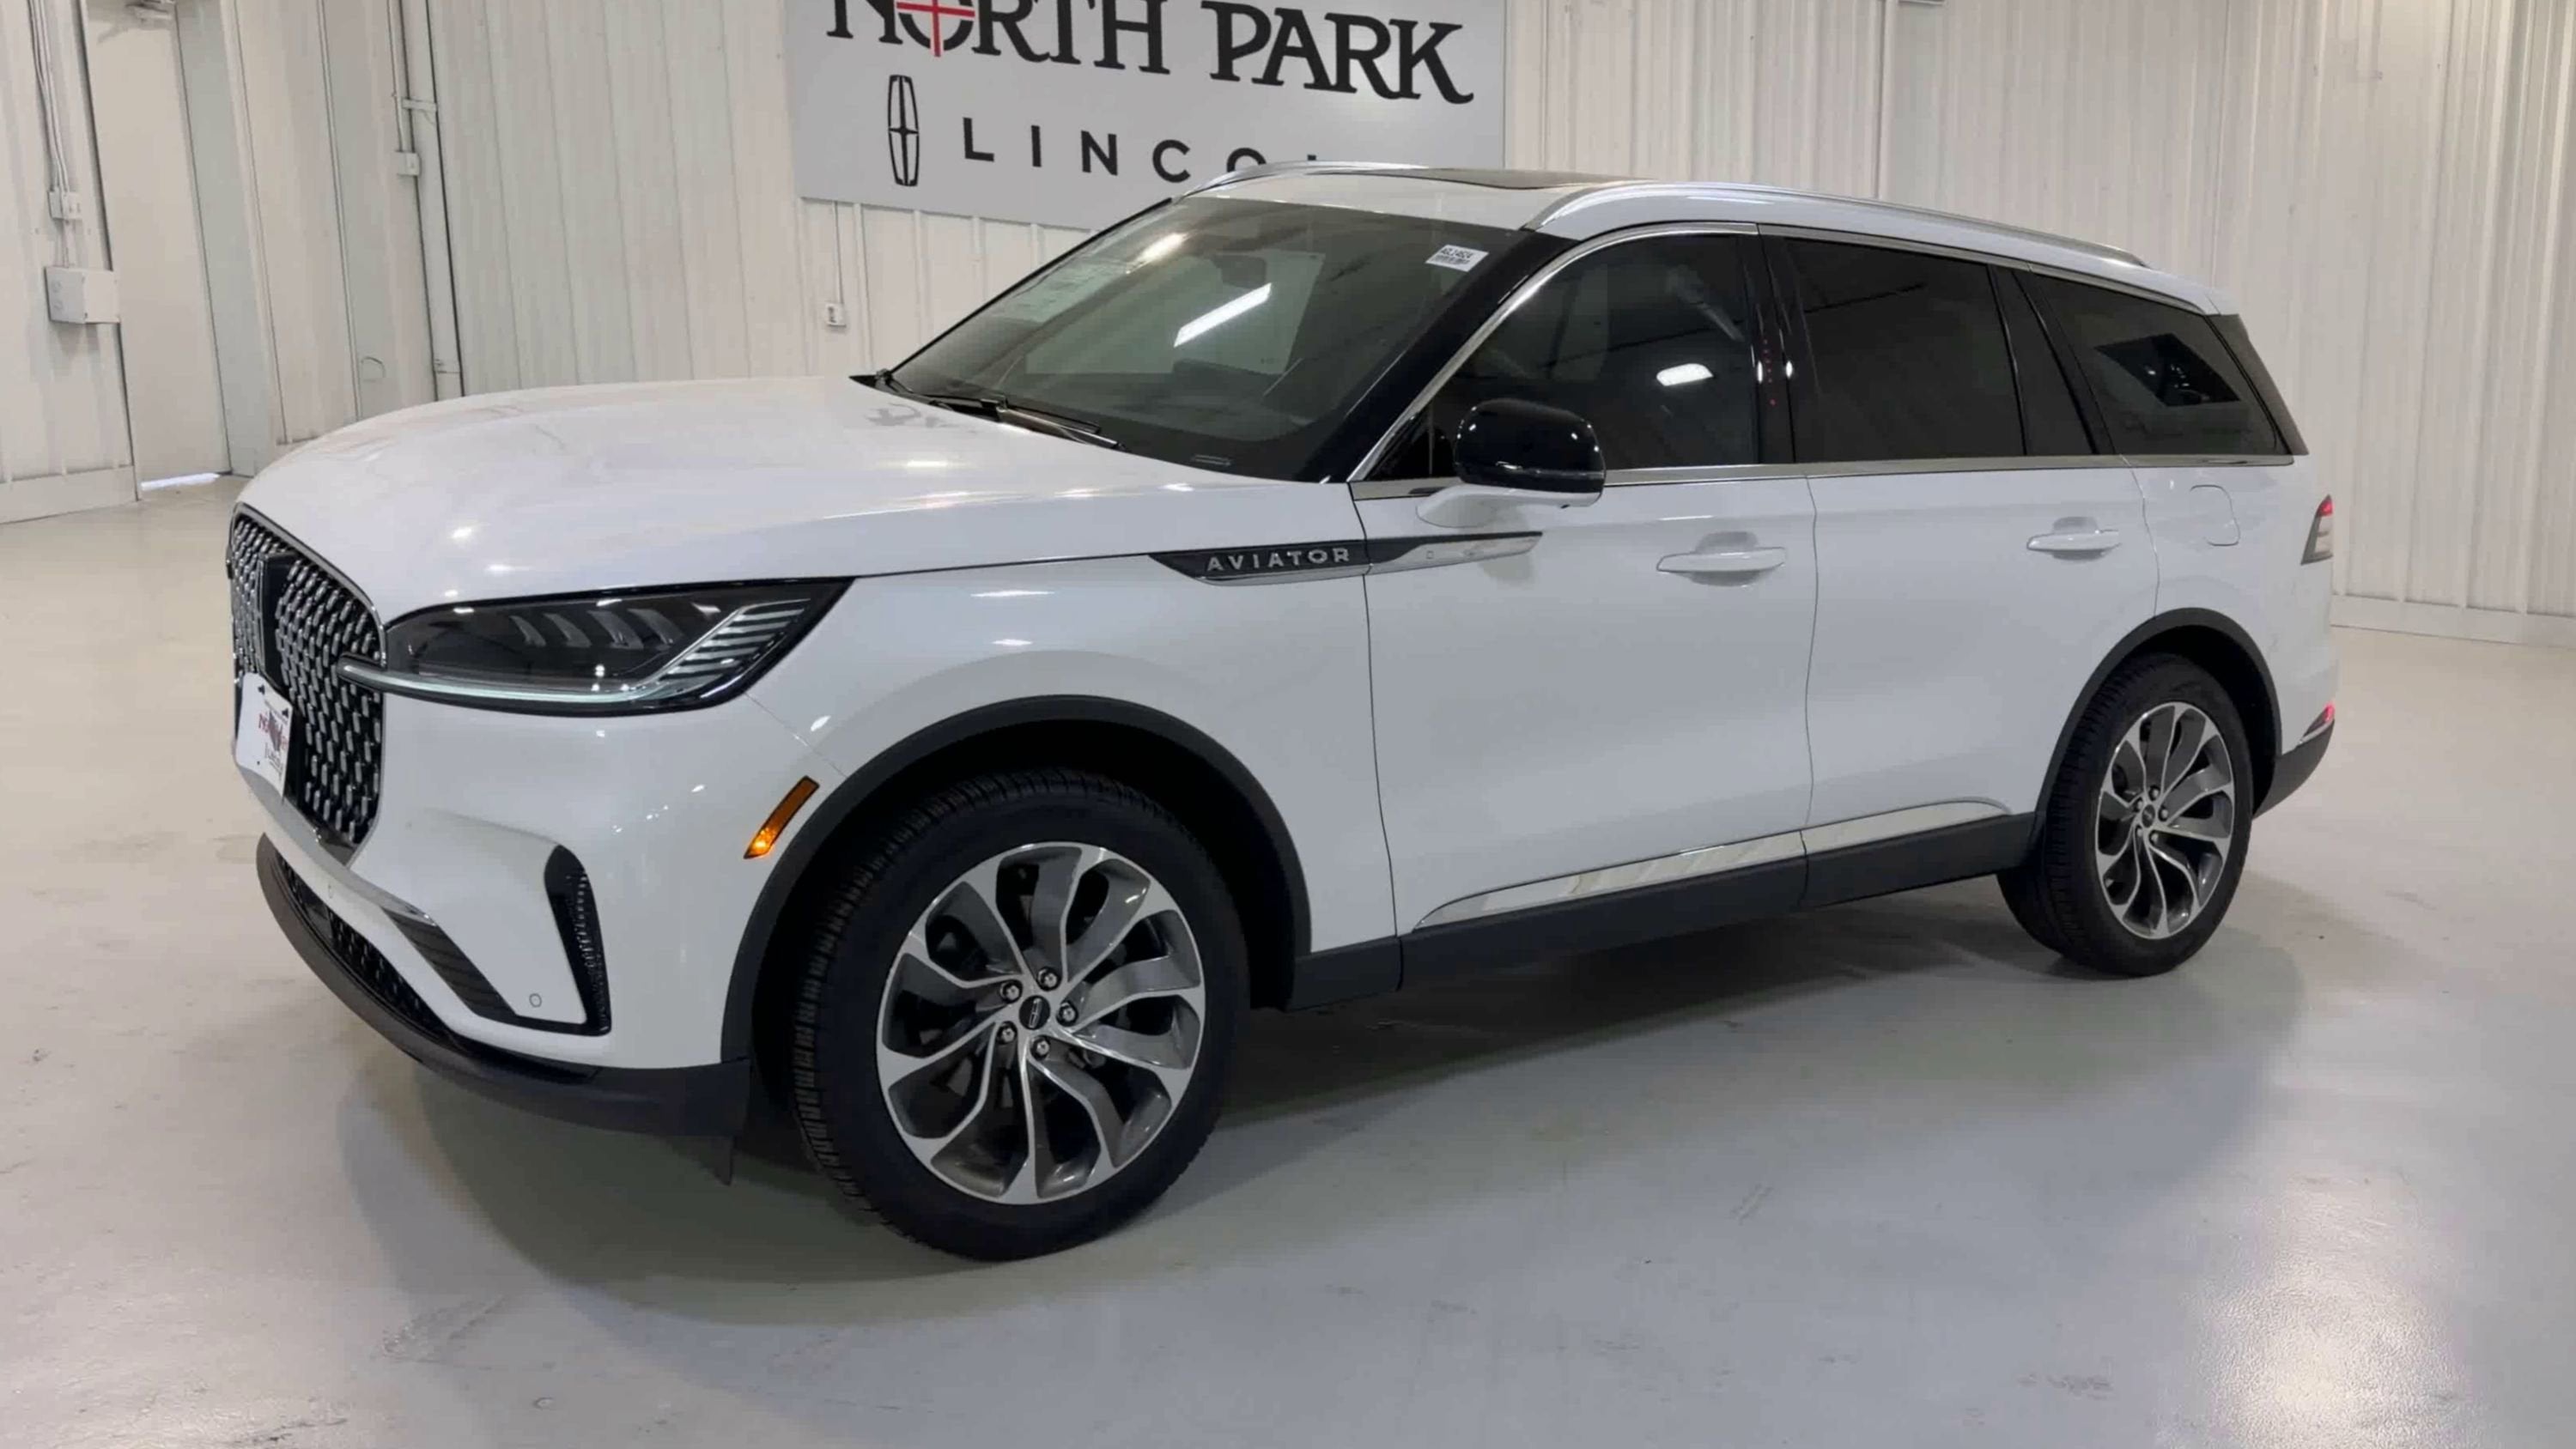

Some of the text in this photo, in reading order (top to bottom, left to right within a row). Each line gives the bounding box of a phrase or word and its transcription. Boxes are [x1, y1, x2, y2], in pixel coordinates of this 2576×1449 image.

[1200, 0, 1473, 104] PARK
[963, 118, 1317, 183] LINC
[1206, 547, 1350, 571] AVIATOR
